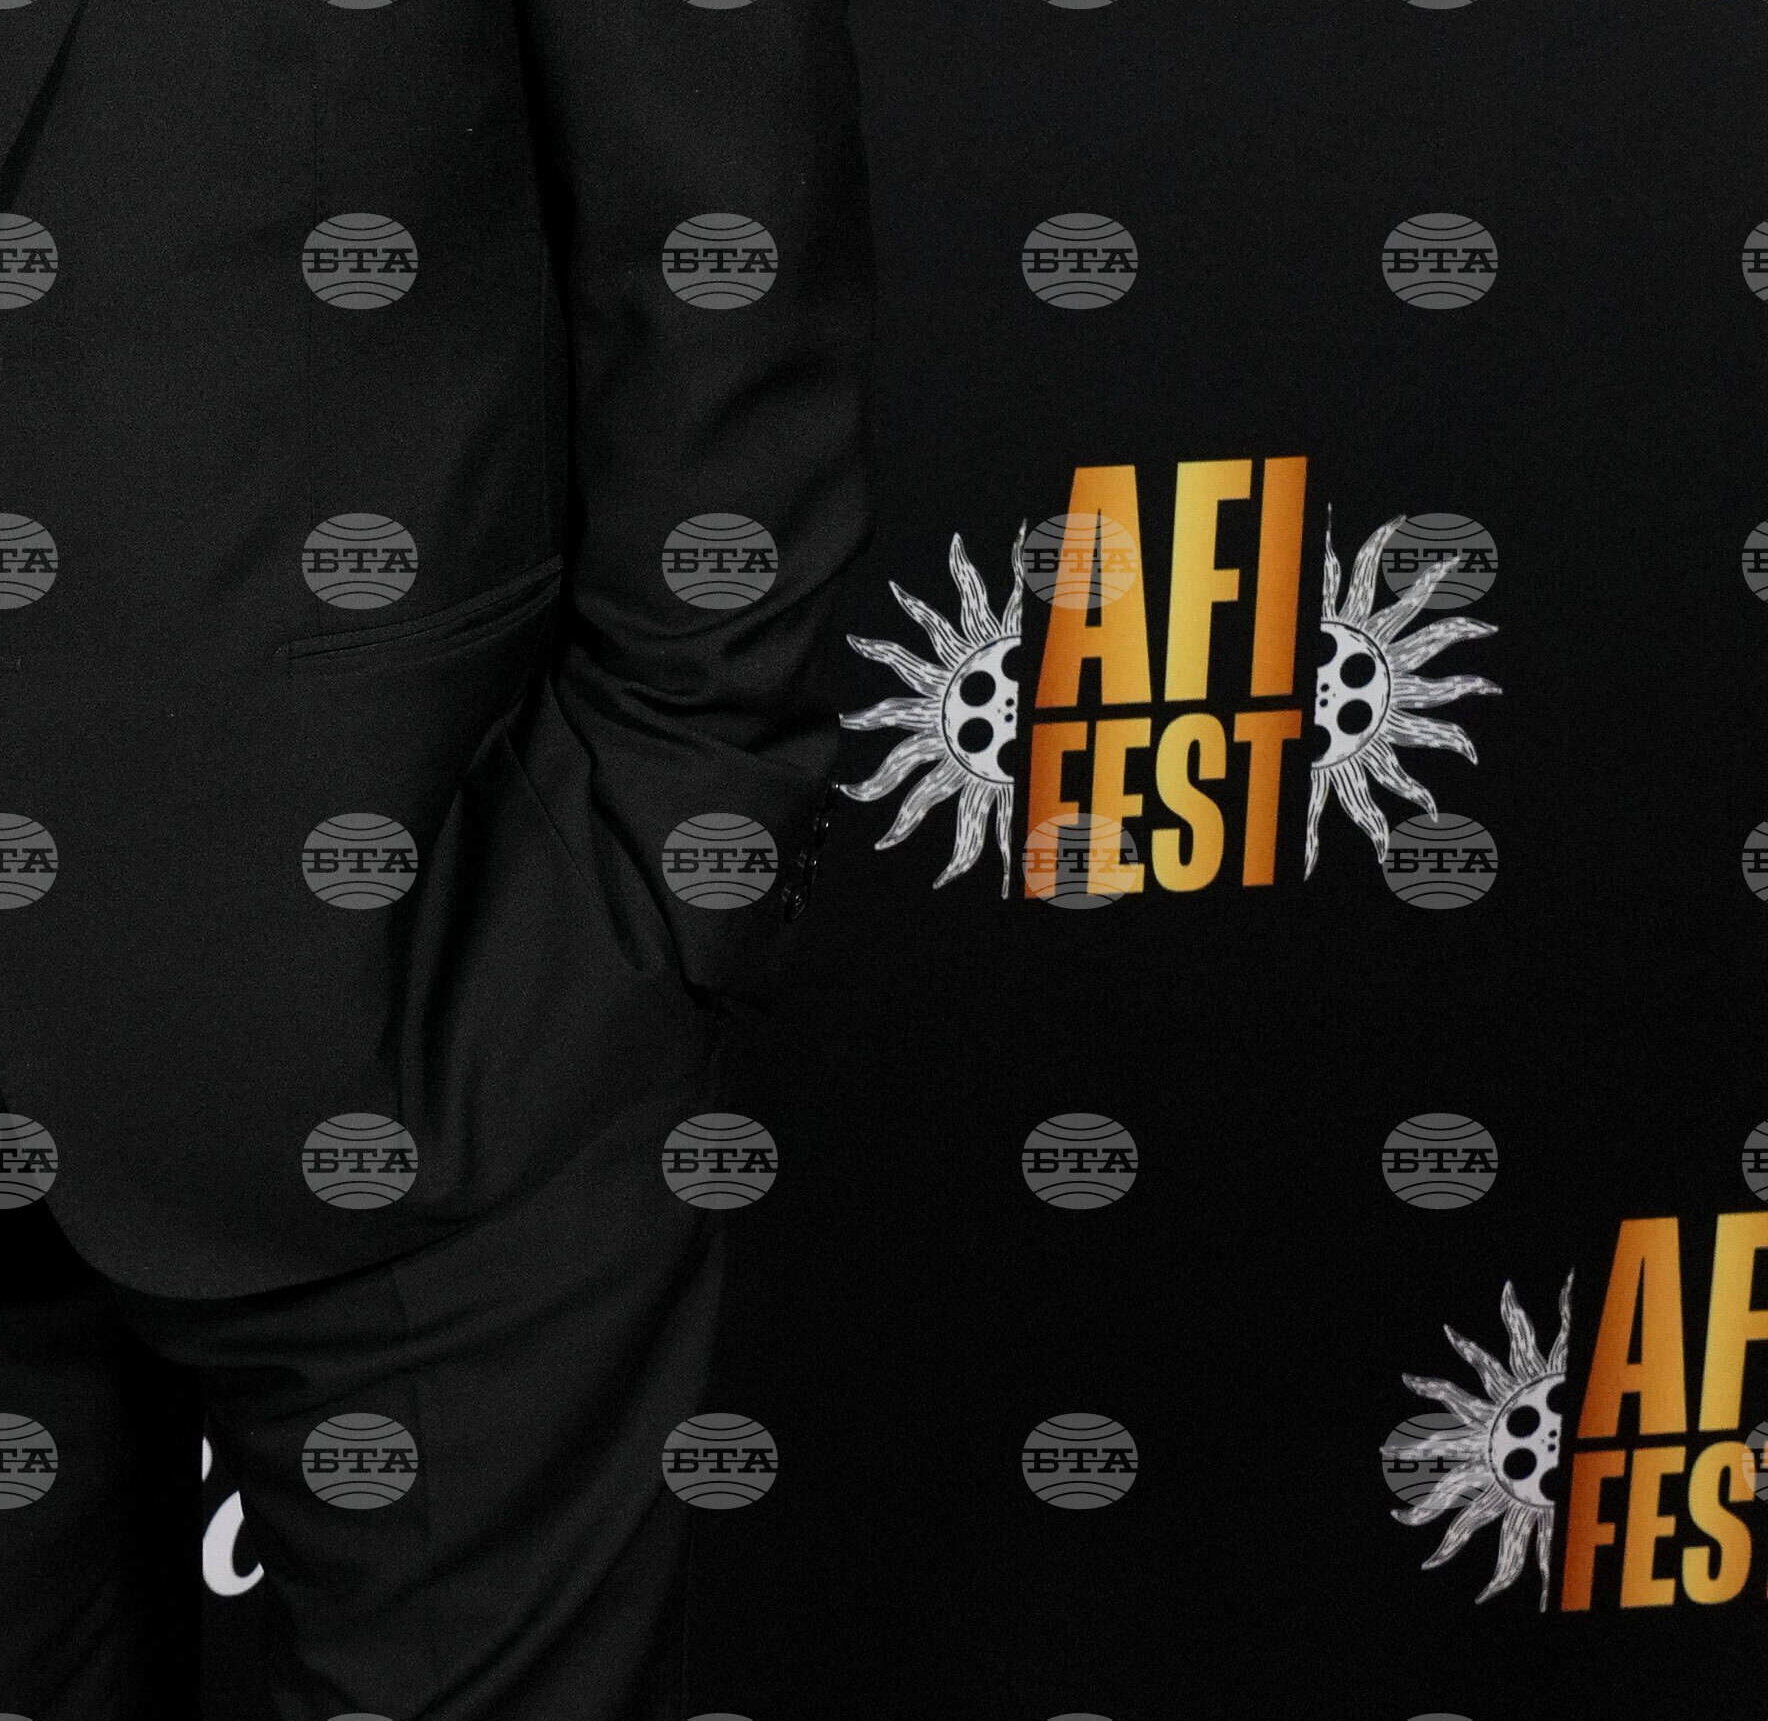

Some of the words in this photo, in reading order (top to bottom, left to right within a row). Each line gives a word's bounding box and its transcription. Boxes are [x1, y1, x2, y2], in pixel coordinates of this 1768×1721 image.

[1034, 455, 1308, 709] AFI
[1023, 708, 1303, 900] FEST
[1561, 1440, 1768, 1613] FES
